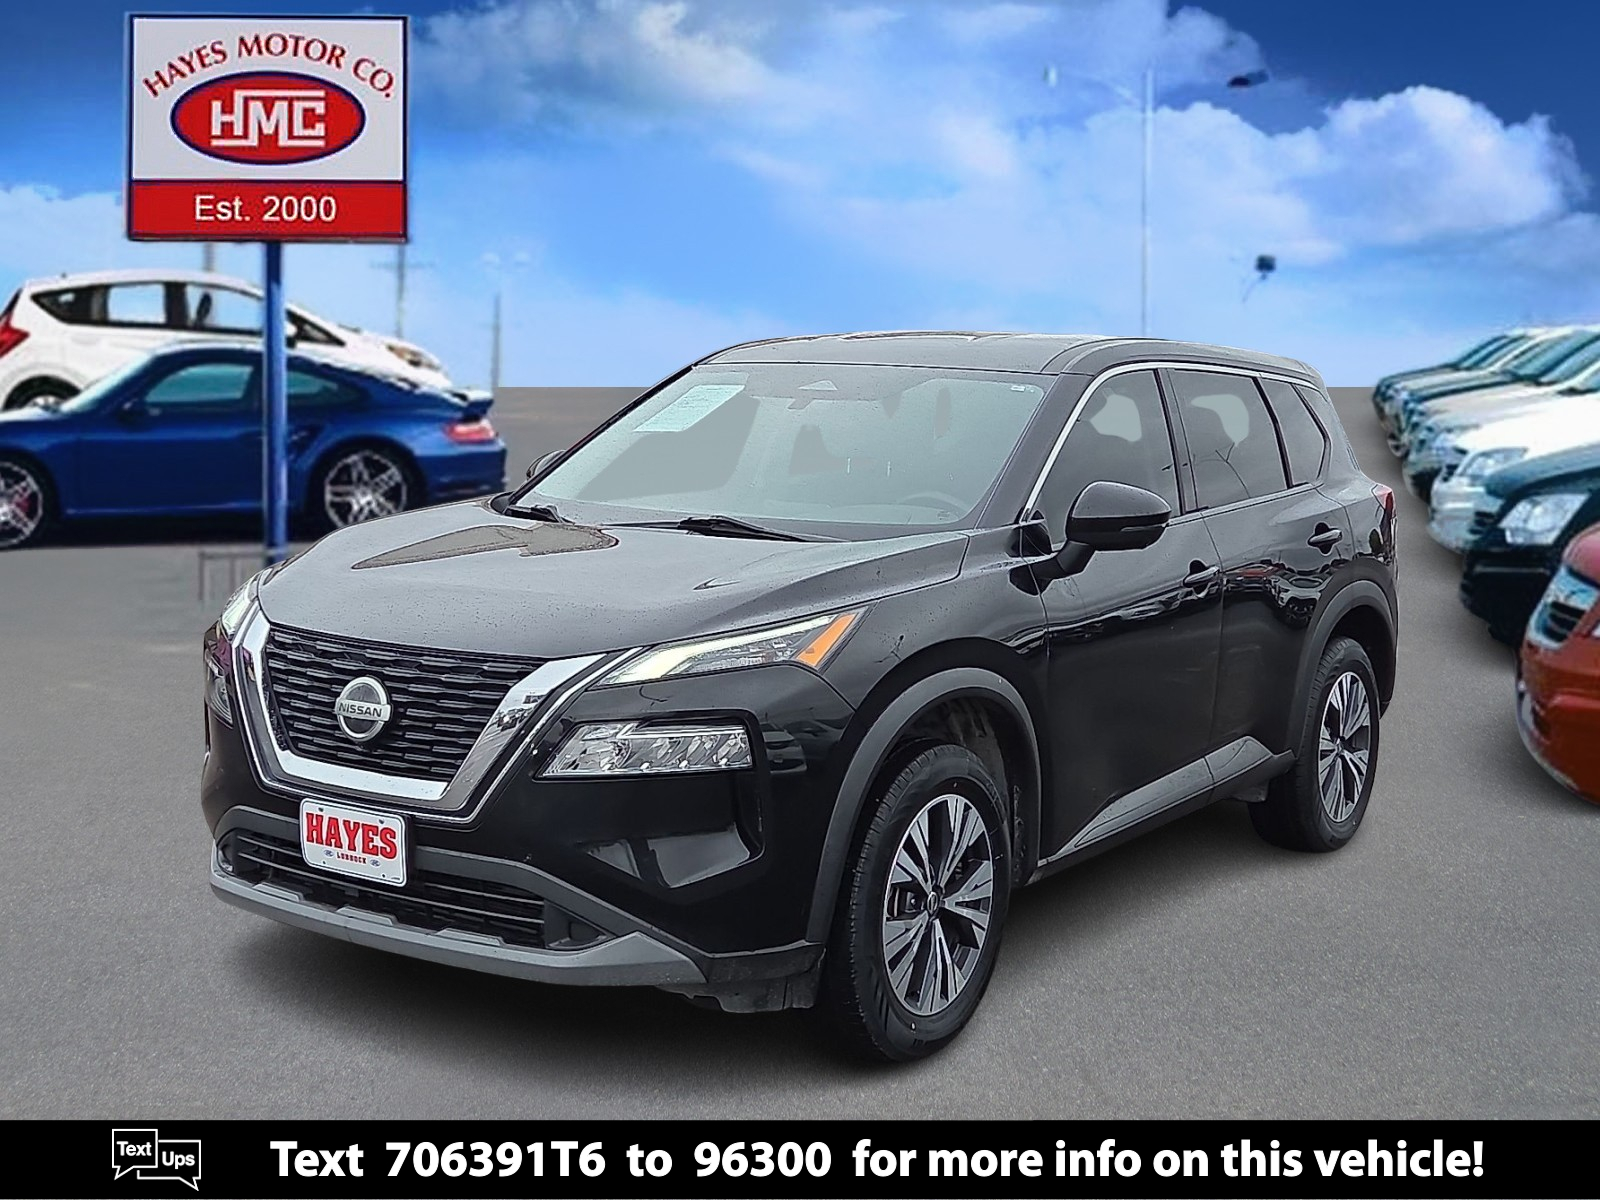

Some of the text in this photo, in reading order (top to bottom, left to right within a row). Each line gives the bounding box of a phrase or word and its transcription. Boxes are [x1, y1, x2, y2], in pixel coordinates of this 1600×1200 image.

[143, 33, 395, 98] HAYES MOTOR CO.
[210, 89, 326, 147] HMC
[194, 194, 337, 222] Est. 2000
[338, 702, 383, 718] NISSAN
[305, 812, 398, 860] HAYES
